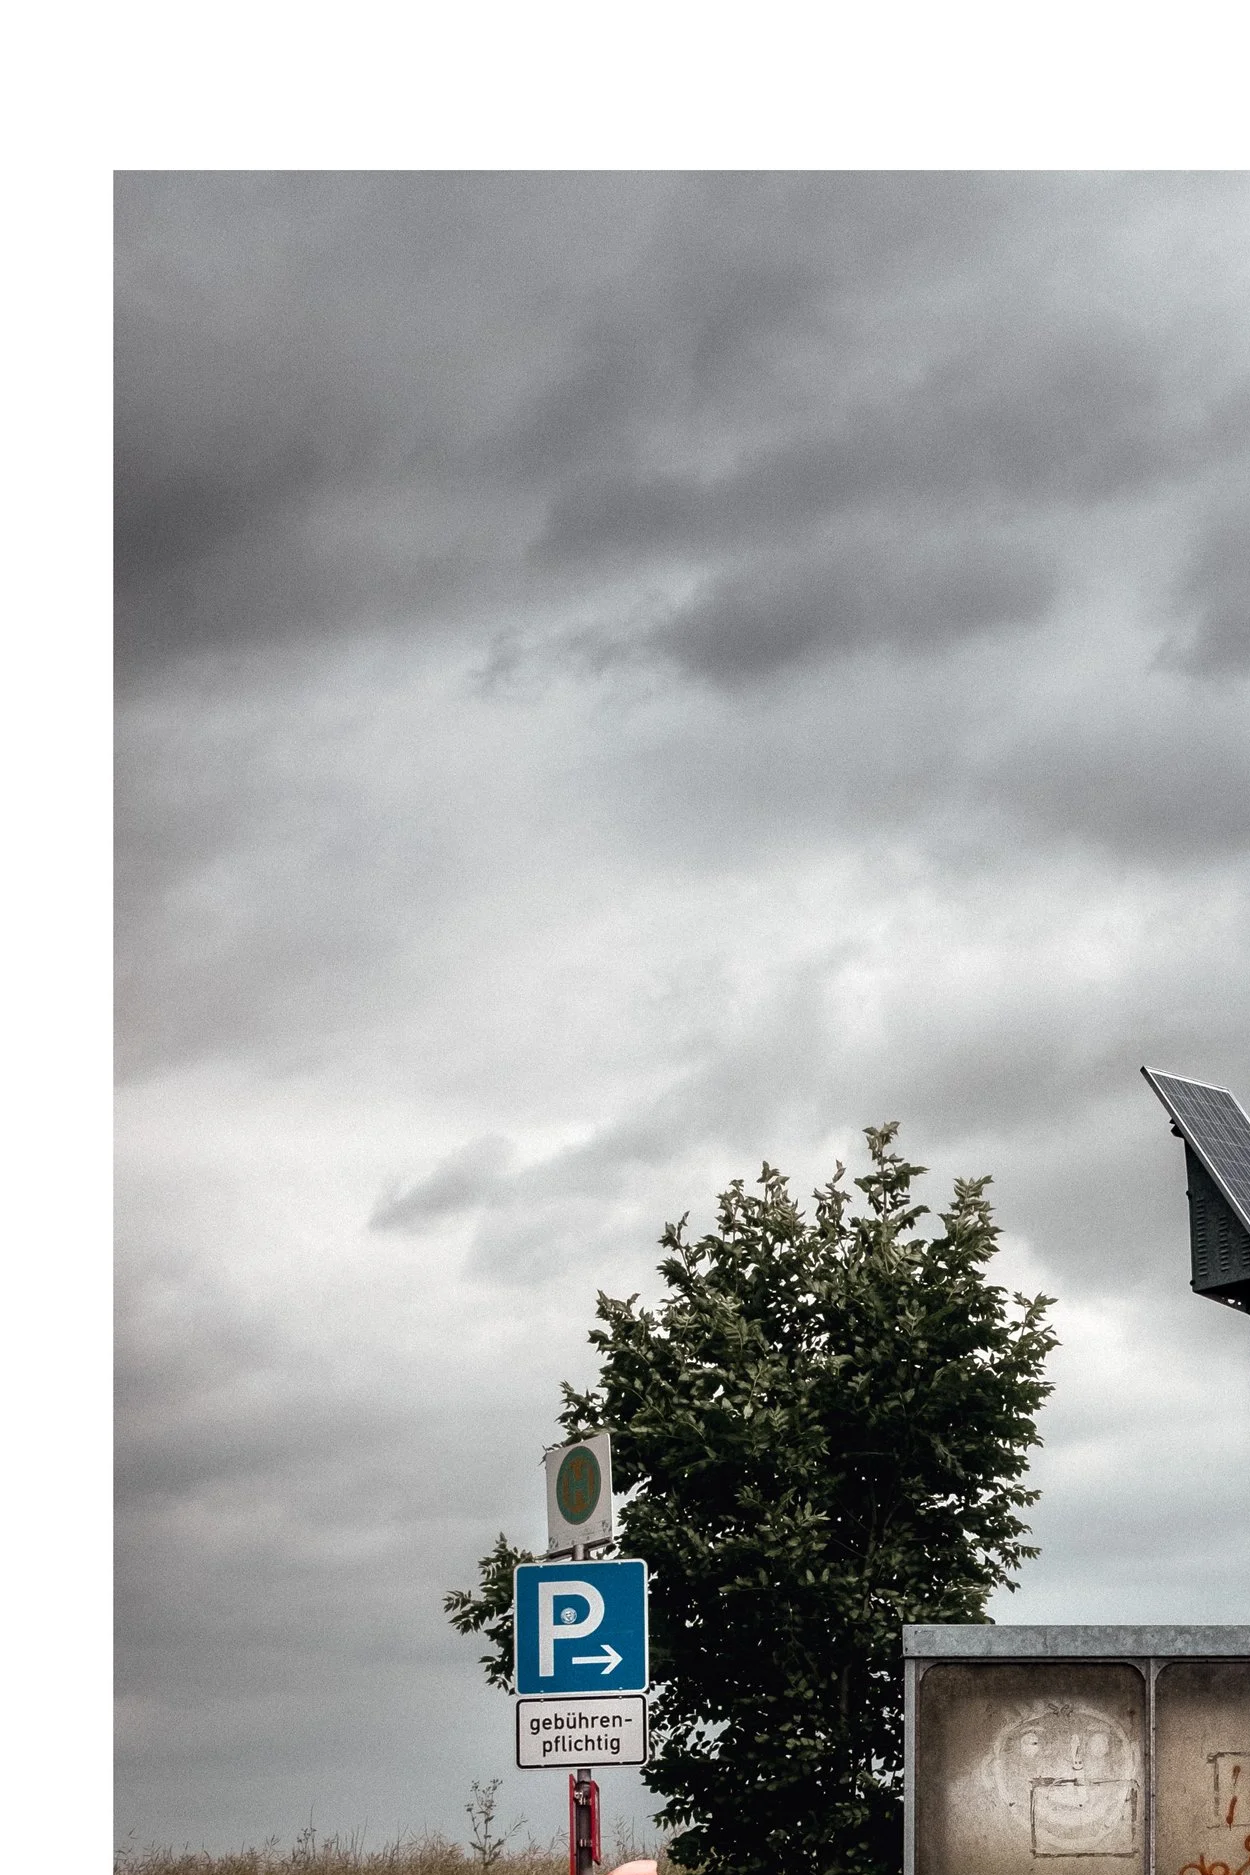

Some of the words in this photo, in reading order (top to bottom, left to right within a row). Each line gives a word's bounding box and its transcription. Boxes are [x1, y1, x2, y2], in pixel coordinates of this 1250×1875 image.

[538, 1580, 605, 1677] P
[530, 1712, 633, 1735] gebühren-
[542, 1734, 620, 1757] pflichtig
